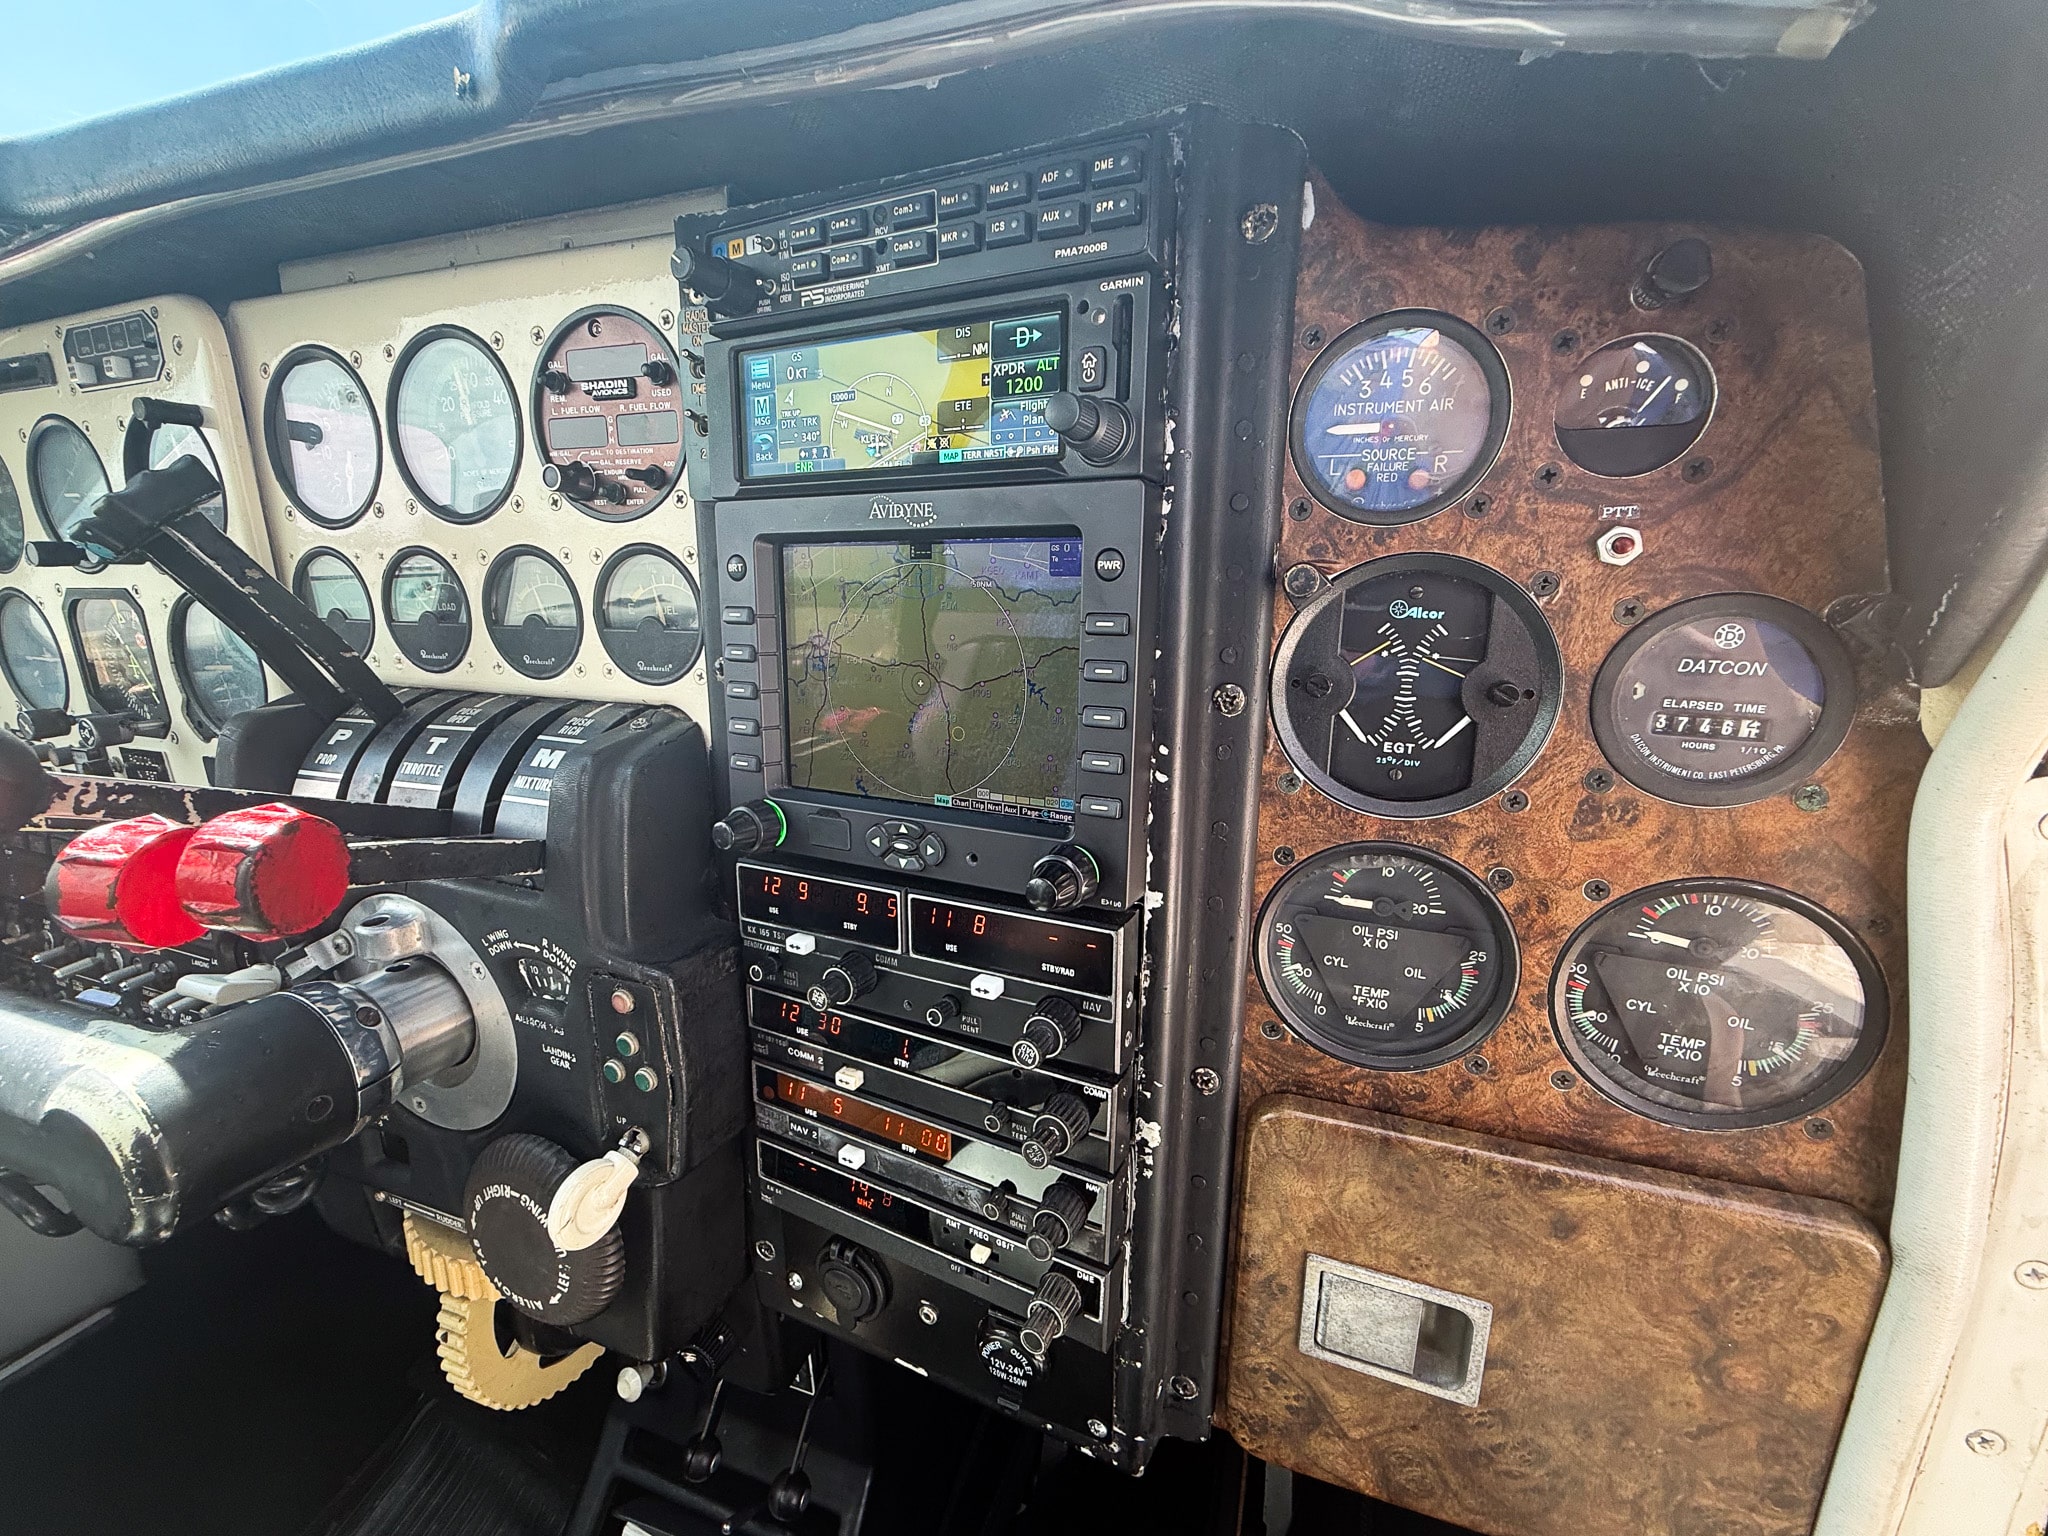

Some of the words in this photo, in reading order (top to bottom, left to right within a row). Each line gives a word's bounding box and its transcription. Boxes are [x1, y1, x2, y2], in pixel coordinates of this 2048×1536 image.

[1094, 158, 1114, 172] DME
[1041, 171, 1059, 183] ADF
[989, 181, 1009, 194] Nav2
[941, 194, 959, 205] Nav1
[893, 204, 914, 215] Com3
[1096, 200, 1114, 212] SPR
[1042, 209, 1060, 222] AUX
[831, 218, 849, 229] Com2
[991, 221, 1005, 233] ICS
[791, 229, 809, 239] Com1
[941, 232, 958, 243] MKR
[732, 243, 741, 256] M
[894, 240, 914, 252] Com3
[1055, 242, 1108, 259] PMA7000B
[831, 253, 850, 264] Com2
[1100, 276, 1145, 292] GARMIN
[824, 290, 866, 304] INCORPORATED
[685, 310, 707, 323] RADIO
[955, 327, 971, 339] DIS
[692, 335, 703, 347] ON
[973, 343, 989, 356] NM
[791, 352, 802, 361] GS
[993, 362, 1025, 376] XPDR
[1037, 357, 1060, 371] ALT
[580, 379, 628, 391] SHADIN
[751, 381, 771, 390] Menu
[1006, 376, 1043, 394] 1200
[1359, 379, 1372, 399] 3
[1380, 373, 1393, 388] 4
[1401, 369, 1414, 387] 5
[1419, 377, 1432, 395] 6
[1605, 378, 1655, 393] ANTI-ICE
[591, 388, 628, 397] AVIONICS
[651, 389, 672, 398] USED
[1580, 388, 1587, 399] E
[580, 405, 601, 415] FLOW
[629, 403, 648, 411] FUEL
[649, 402, 671, 411] FLOW
[954, 400, 972, 411] ETE
[1020, 400, 1048, 411] Flight
[1333, 400, 1425, 416] INSTRUMENT
[1429, 397, 1455, 412] AIR
[754, 417, 772, 426] MSG
[782, 420, 797, 429] DTK
[802, 417, 818, 427] TRK
[1023, 415, 1044, 425] Plan
[1353, 435, 1379, 444] INCHES
[1394, 434, 1429, 443] MERCURY
[615, 448, 654, 456] DESTINATION
[963, 450, 982, 460] TERR
[984, 448, 1005, 459] NRST
[1026, 445, 1041, 455] Psh
[1043, 445, 1059, 455] Flds
[1361, 448, 1417, 462] SOURCE
[755, 452, 773, 461] Back
[943, 452, 959, 461] MAP
[795, 462, 814, 473] ENR
[1329, 459, 1342, 476] L
[1366, 461, 1410, 473] FAILURE
[1434, 455, 1448, 473] R
[1376, 472, 1398, 483] RED
[868, 501, 935, 520] AVIDYNE
[1601, 504, 1639, 519] PTT
[728, 563, 743, 573] BRT
[1097, 559, 1121, 571] PWR
[972, 580, 993, 588] 50NM
[438, 602, 457, 611] LOAD
[1406, 606, 1446, 620] Alcor
[1677, 658, 1769, 677] DATCON
[455, 707, 483, 716] PUSH
[1662, 698, 1724, 713] ELAPSED
[1733, 703, 1767, 715] TIME
[447, 715, 470, 724] OPEN
[566, 716, 595, 727] PUSH
[557, 725, 583, 736] RICH
[327, 729, 353, 746] P
[426, 737, 449, 755] T
[1383, 741, 1416, 755] EGT
[1681, 741, 1716, 751] HOURS
[1740, 746, 1768, 755] 1/10
[315, 752, 338, 766] PROP
[530, 748, 567, 770] M
[1630, 733, 1650, 758] DATCON
[1648, 752, 1693, 780] INSTRUMENT
[1708, 771, 1728, 781] EAST
[400, 761, 444, 778] THROTTLE
[514, 775, 553, 792] MIXTURE
[952, 799, 970, 808] Chart
[972, 801, 985, 810] Trip
[987, 803, 1002, 812] Nrst
[1004, 805, 1017, 814] Aux
[1022, 808, 1039, 818] Page
[1050, 811, 1073, 822] Range
[1381, 867, 1395, 878] 10
[1705, 905, 1722, 916] 10
[843, 921, 858, 931] STBY
[1275, 922, 1293, 934] 50
[487, 929, 510, 942] WING
[759, 928, 770, 937] 165
[1352, 925, 1374, 938] OIL
[1376, 928, 1399, 941] PSI
[488, 940, 513, 957] DOWN
[1375, 939, 1389, 950] 10
[542, 938, 549, 949] R
[552, 944, 577, 969] WING
[1469, 951, 1487, 962] 25
[542, 949, 573, 976] DOWN
[874, 954, 898, 967] COMM
[1323, 955, 1349, 968] CYL
[547, 965, 553, 975] 0
[1041, 962, 1075, 977] STBY/RAD
[1404, 967, 1427, 980] OIL
[1666, 967, 1693, 982] OIL
[1697, 971, 1726, 987] PSI
[1353, 984, 1390, 998] TEMP
[1693, 983, 1711, 996] 10
[1082, 1000, 1102, 1013] NAV
[1314, 1004, 1327, 1016] 10
[1626, 998, 1657, 1014] CYL
[1812, 1000, 1834, 1014] 25
[1727, 1015, 1755, 1030] OIL
[796, 1026, 809, 1037] USE
[1660, 1032, 1707, 1049] TEMP
[787, 1047, 815, 1062] COMM
[550, 1056, 571, 1070] GEAR
[893, 1057, 910, 1069] STBY
[1731, 1075, 1743, 1087] 5
[1083, 1086, 1108, 1100] COMM
[804, 1107, 818, 1117] USE
[616, 1116, 627, 1125] UP
[790, 1122, 809, 1136] NAV
[812, 1130, 818, 1139] 2
[1011, 1123, 1028, 1133] PULL
[1011, 1131, 1028, 1141] TEST
[483, 1184, 511, 1201] RIGHT
[1085, 1182, 1101, 1193] NAV
[945, 1218, 961, 1230] RMT
[968, 1227, 990, 1241] FREQ
[1009, 1219, 1027, 1231] IDENT
[1076, 1270, 1095, 1284] DME
[493, 1276, 544, 1311] AILERON
[981, 1341, 1003, 1359] POWER
[1010, 1348, 1033, 1376] OUTLET
[990, 1357, 1024, 1377] 12V-24V
[989, 1366, 1028, 1388] 120W-250W
